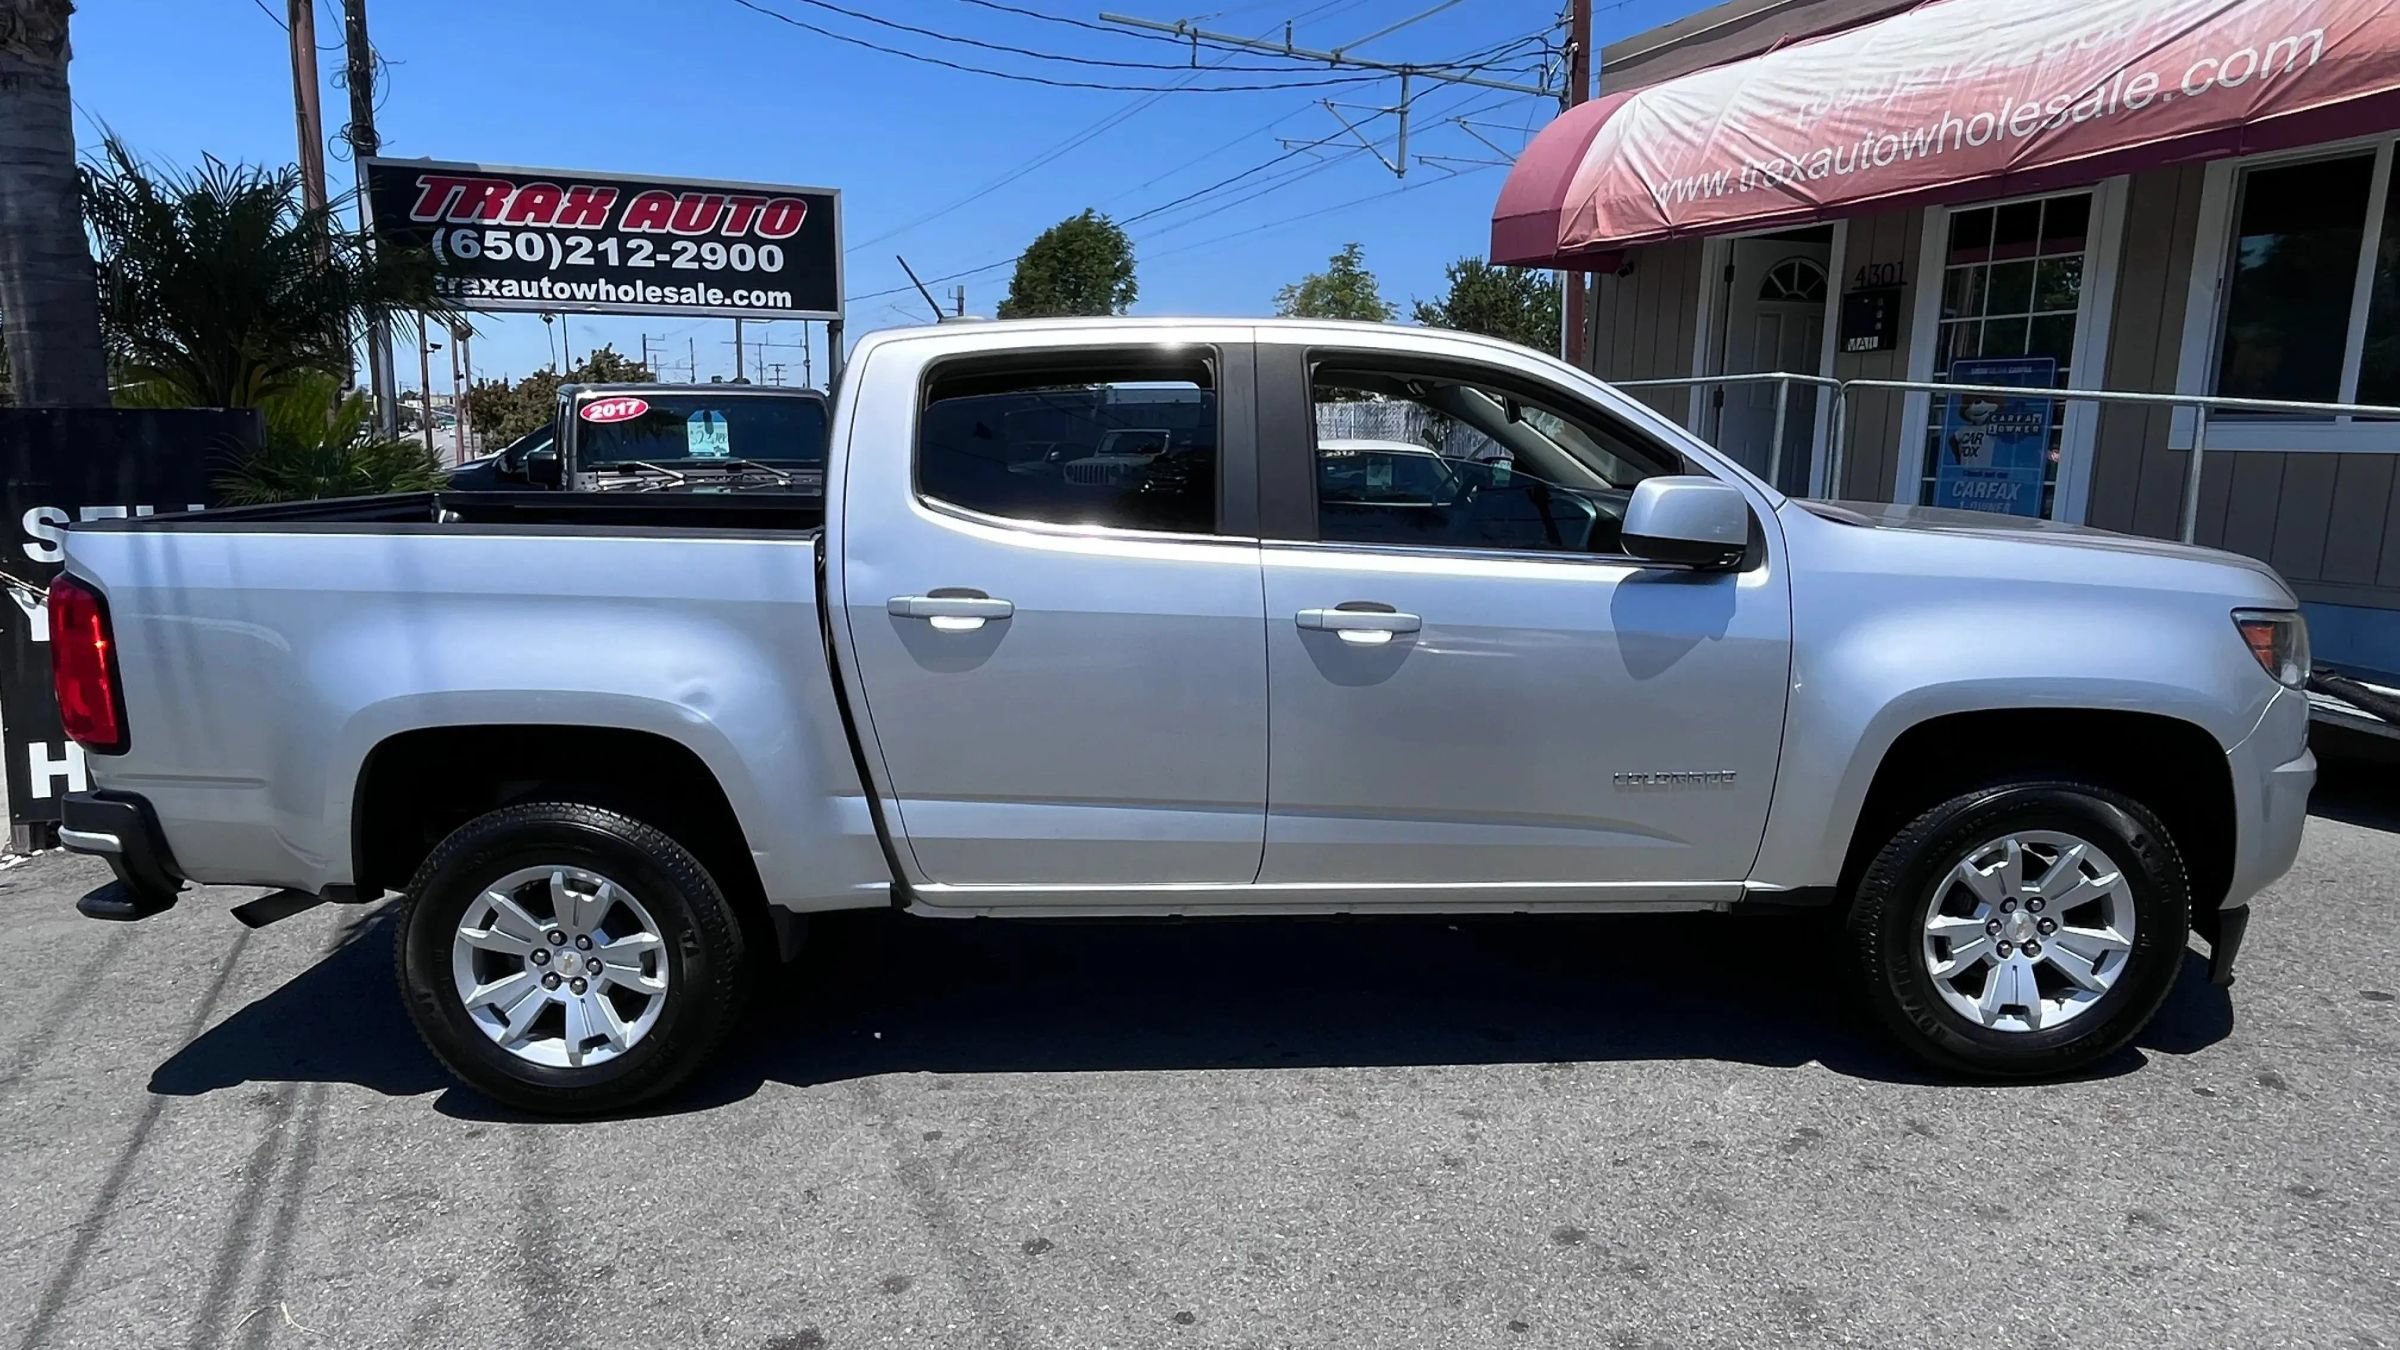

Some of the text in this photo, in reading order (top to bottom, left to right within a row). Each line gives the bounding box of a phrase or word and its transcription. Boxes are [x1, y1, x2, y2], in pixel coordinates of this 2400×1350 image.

[1652, 27, 2325, 208] www.traxautowholesale.com
[410, 174, 807, 239] TRAX AUTO
[432, 227, 784, 273] (650)212-2900
[589, 401, 637, 420] 2017
[1952, 480, 2021, 500] CARFAX
